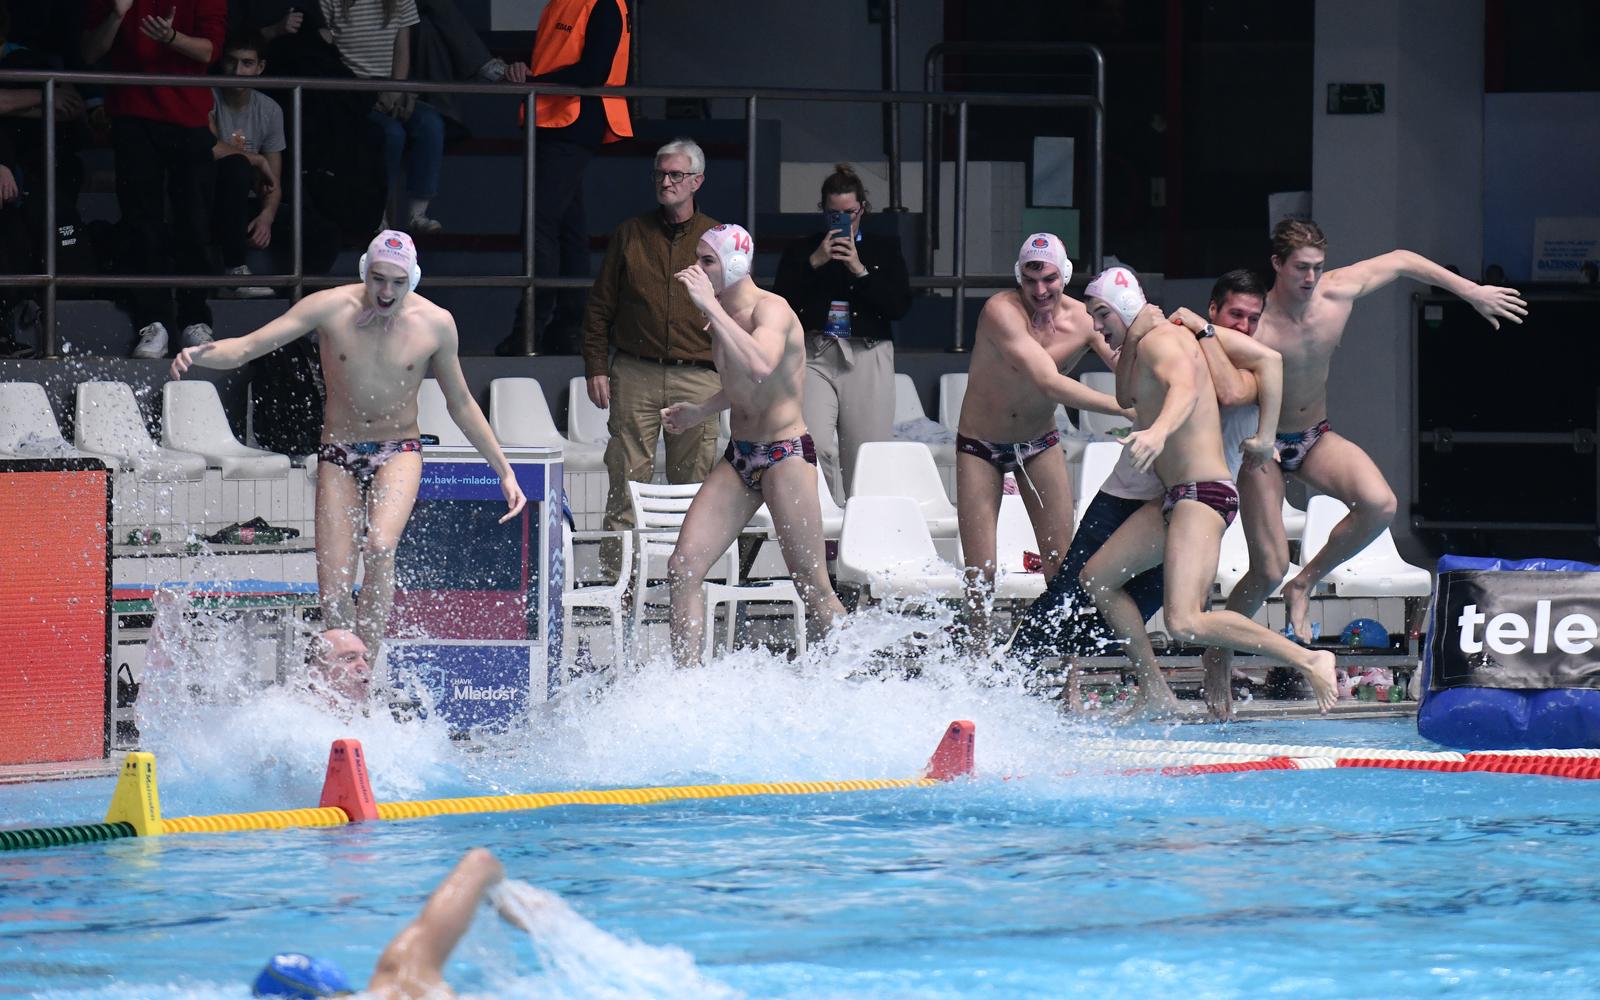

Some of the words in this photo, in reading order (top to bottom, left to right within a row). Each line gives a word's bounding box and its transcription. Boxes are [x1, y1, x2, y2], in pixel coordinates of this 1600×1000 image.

[732, 231, 751, 255] 14
[1114, 270, 1129, 288] 4
[1457, 599, 1598, 655] tele
[454, 685, 517, 701] Mladost
